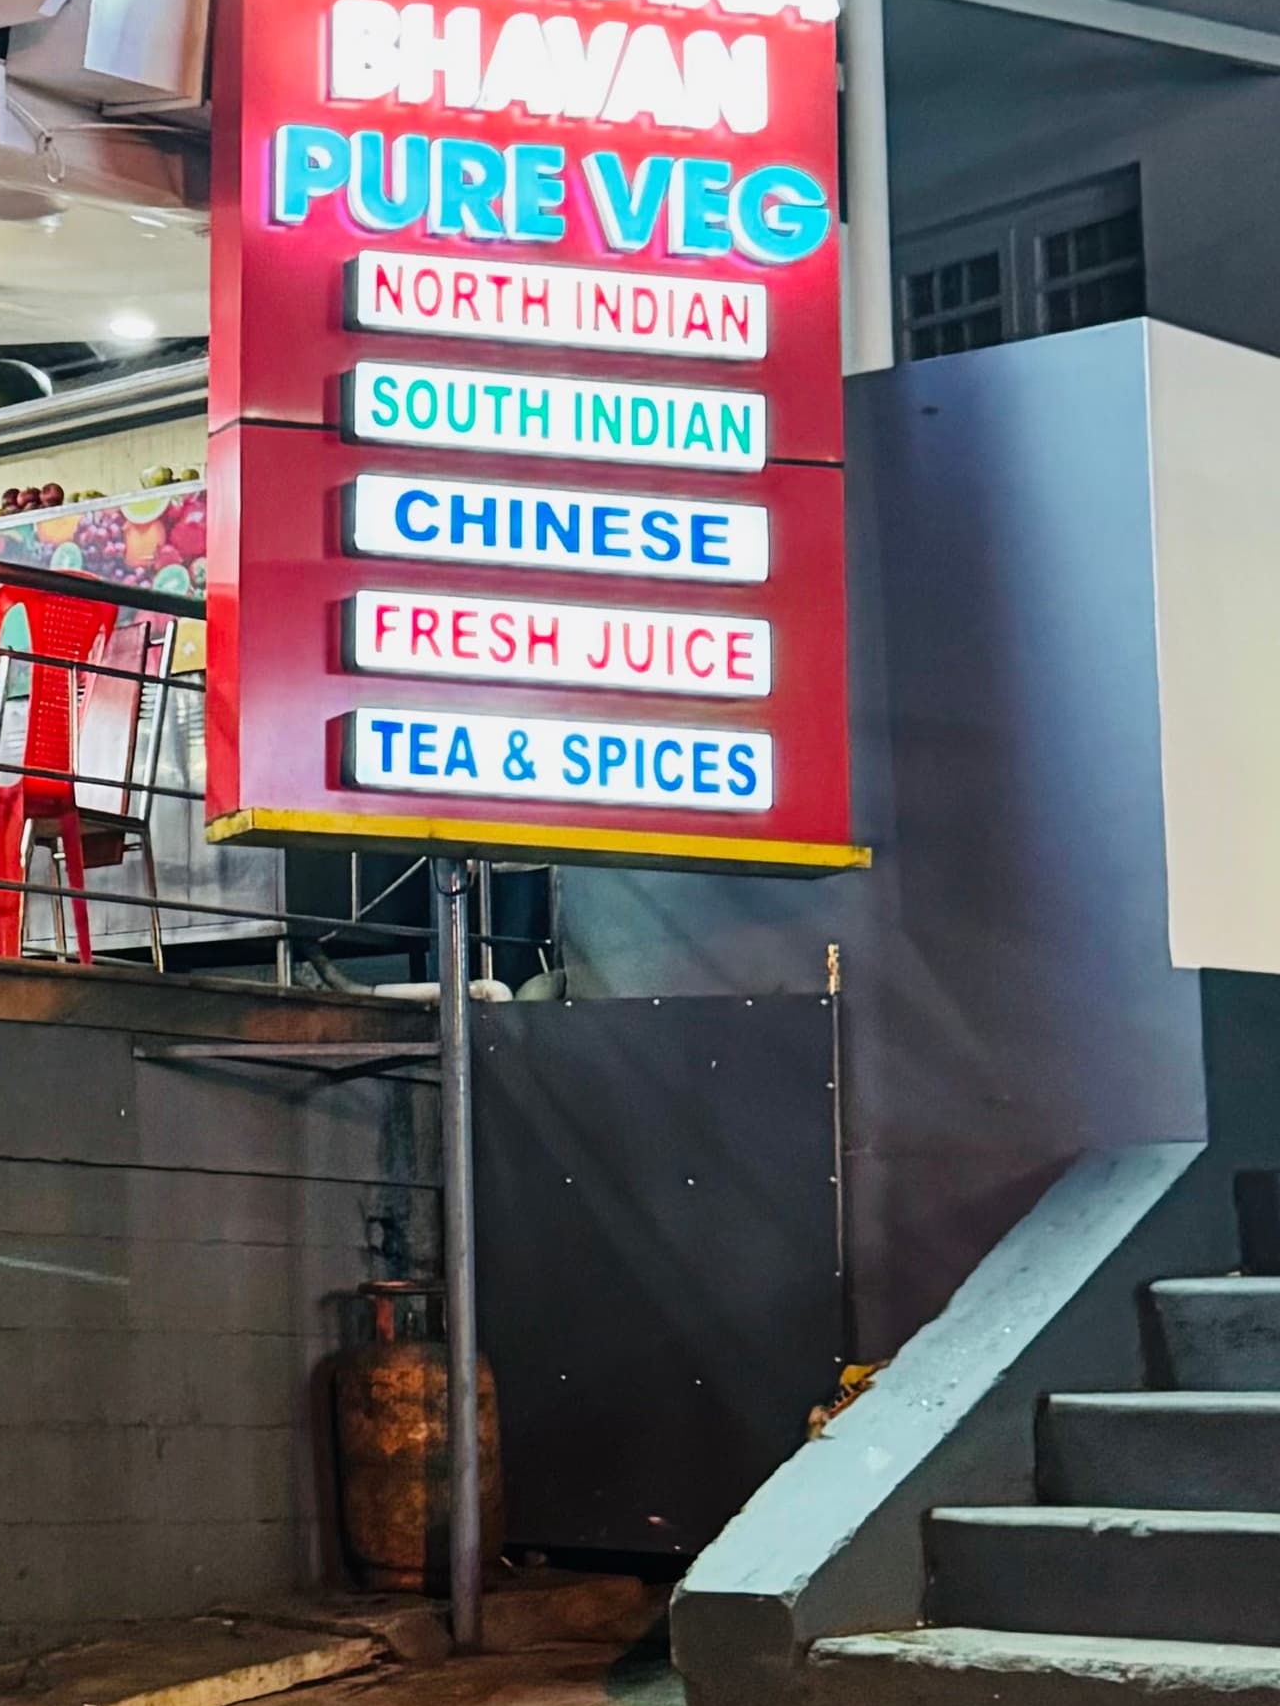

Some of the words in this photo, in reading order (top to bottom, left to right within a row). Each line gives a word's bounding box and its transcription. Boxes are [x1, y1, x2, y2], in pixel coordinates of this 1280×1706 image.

[272, 124, 566, 243] PURE
[581, 150, 832, 267] VEG
[374, 263, 550, 328] NORTH
[575, 280, 751, 346] INDIAN
[371, 375, 550, 439] SOUTH
[573, 393, 752, 456] INDIAN
[394, 489, 731, 566] CHINESE
[374, 604, 560, 666] FRESH
[586, 621, 755, 682] JUICE
[371, 719, 479, 779] TEA
[501, 730, 538, 782] &
[562, 733, 758, 797] SPICES
